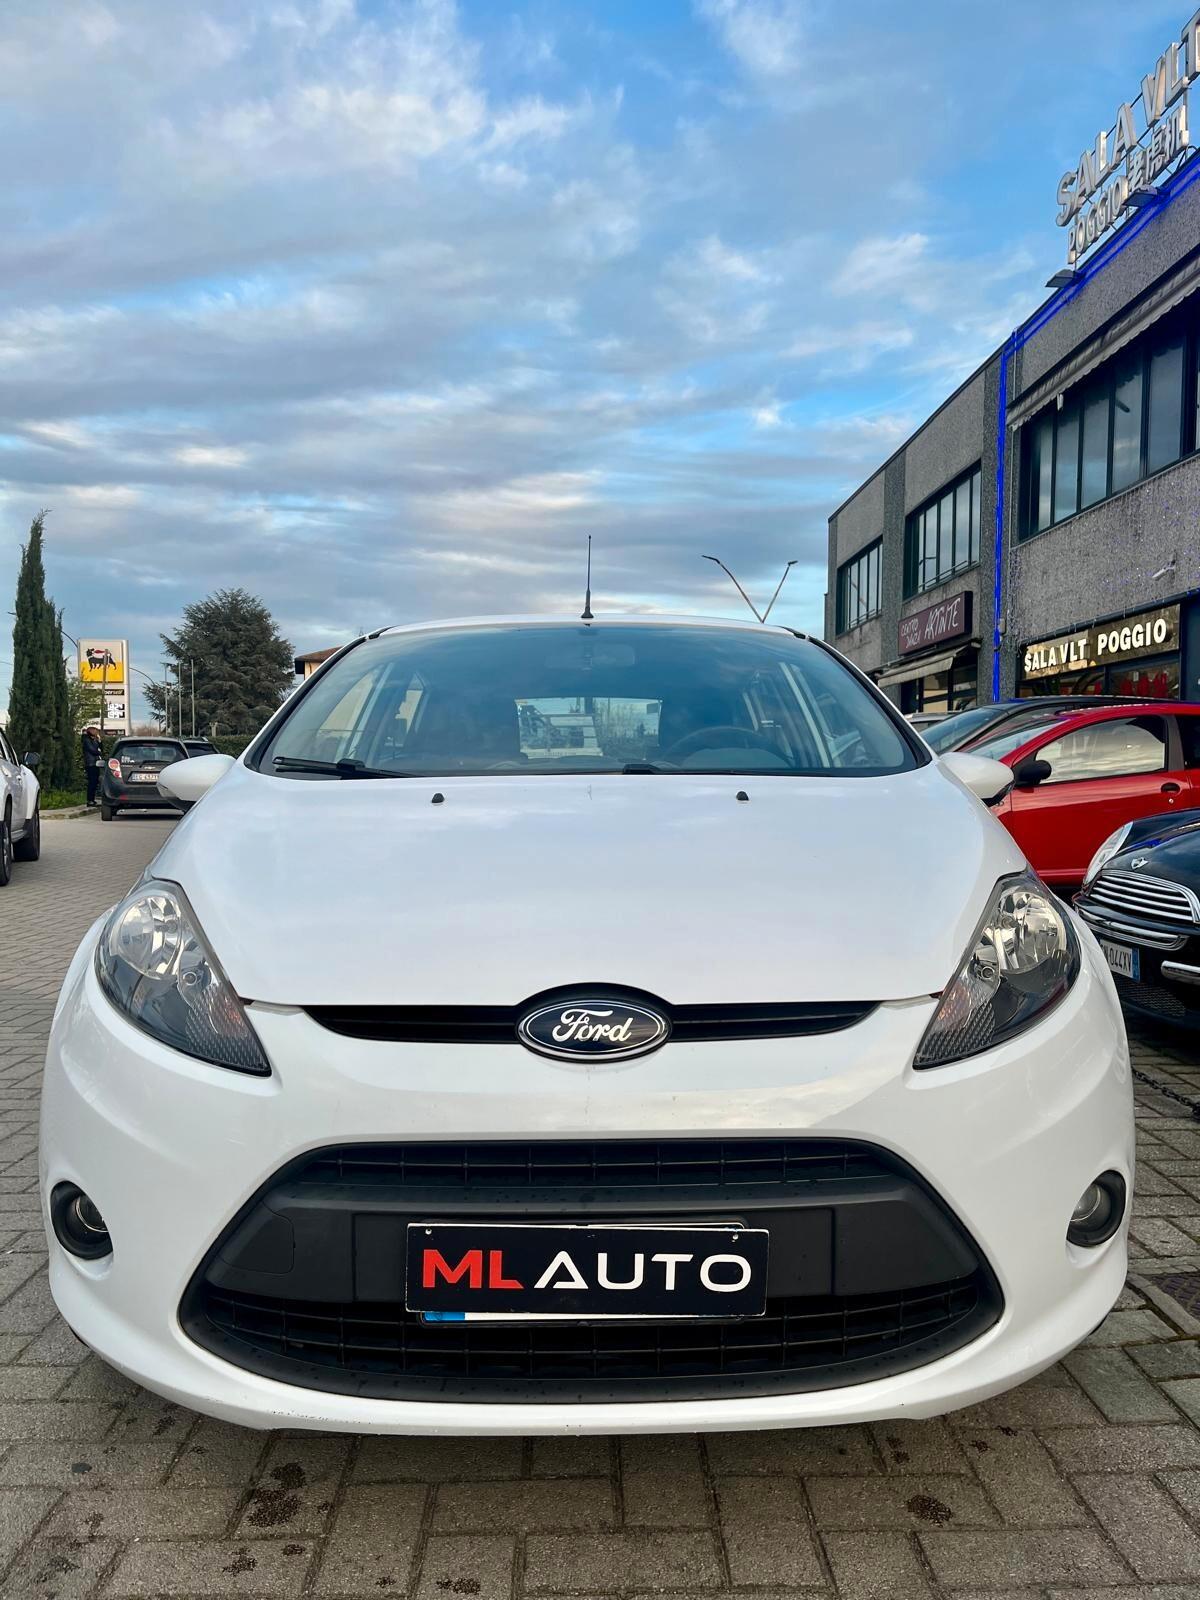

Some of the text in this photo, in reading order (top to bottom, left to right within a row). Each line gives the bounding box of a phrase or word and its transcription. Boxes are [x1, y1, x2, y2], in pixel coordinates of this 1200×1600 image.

[1056, 102, 1137, 227] SALA
[1068, 175, 1129, 264] POGGIO
[1024, 618, 1167, 672] SALA VLT POGGIO
[552, 1008, 633, 1042] Ford
[422, 1249, 752, 1293] ML AUTO
